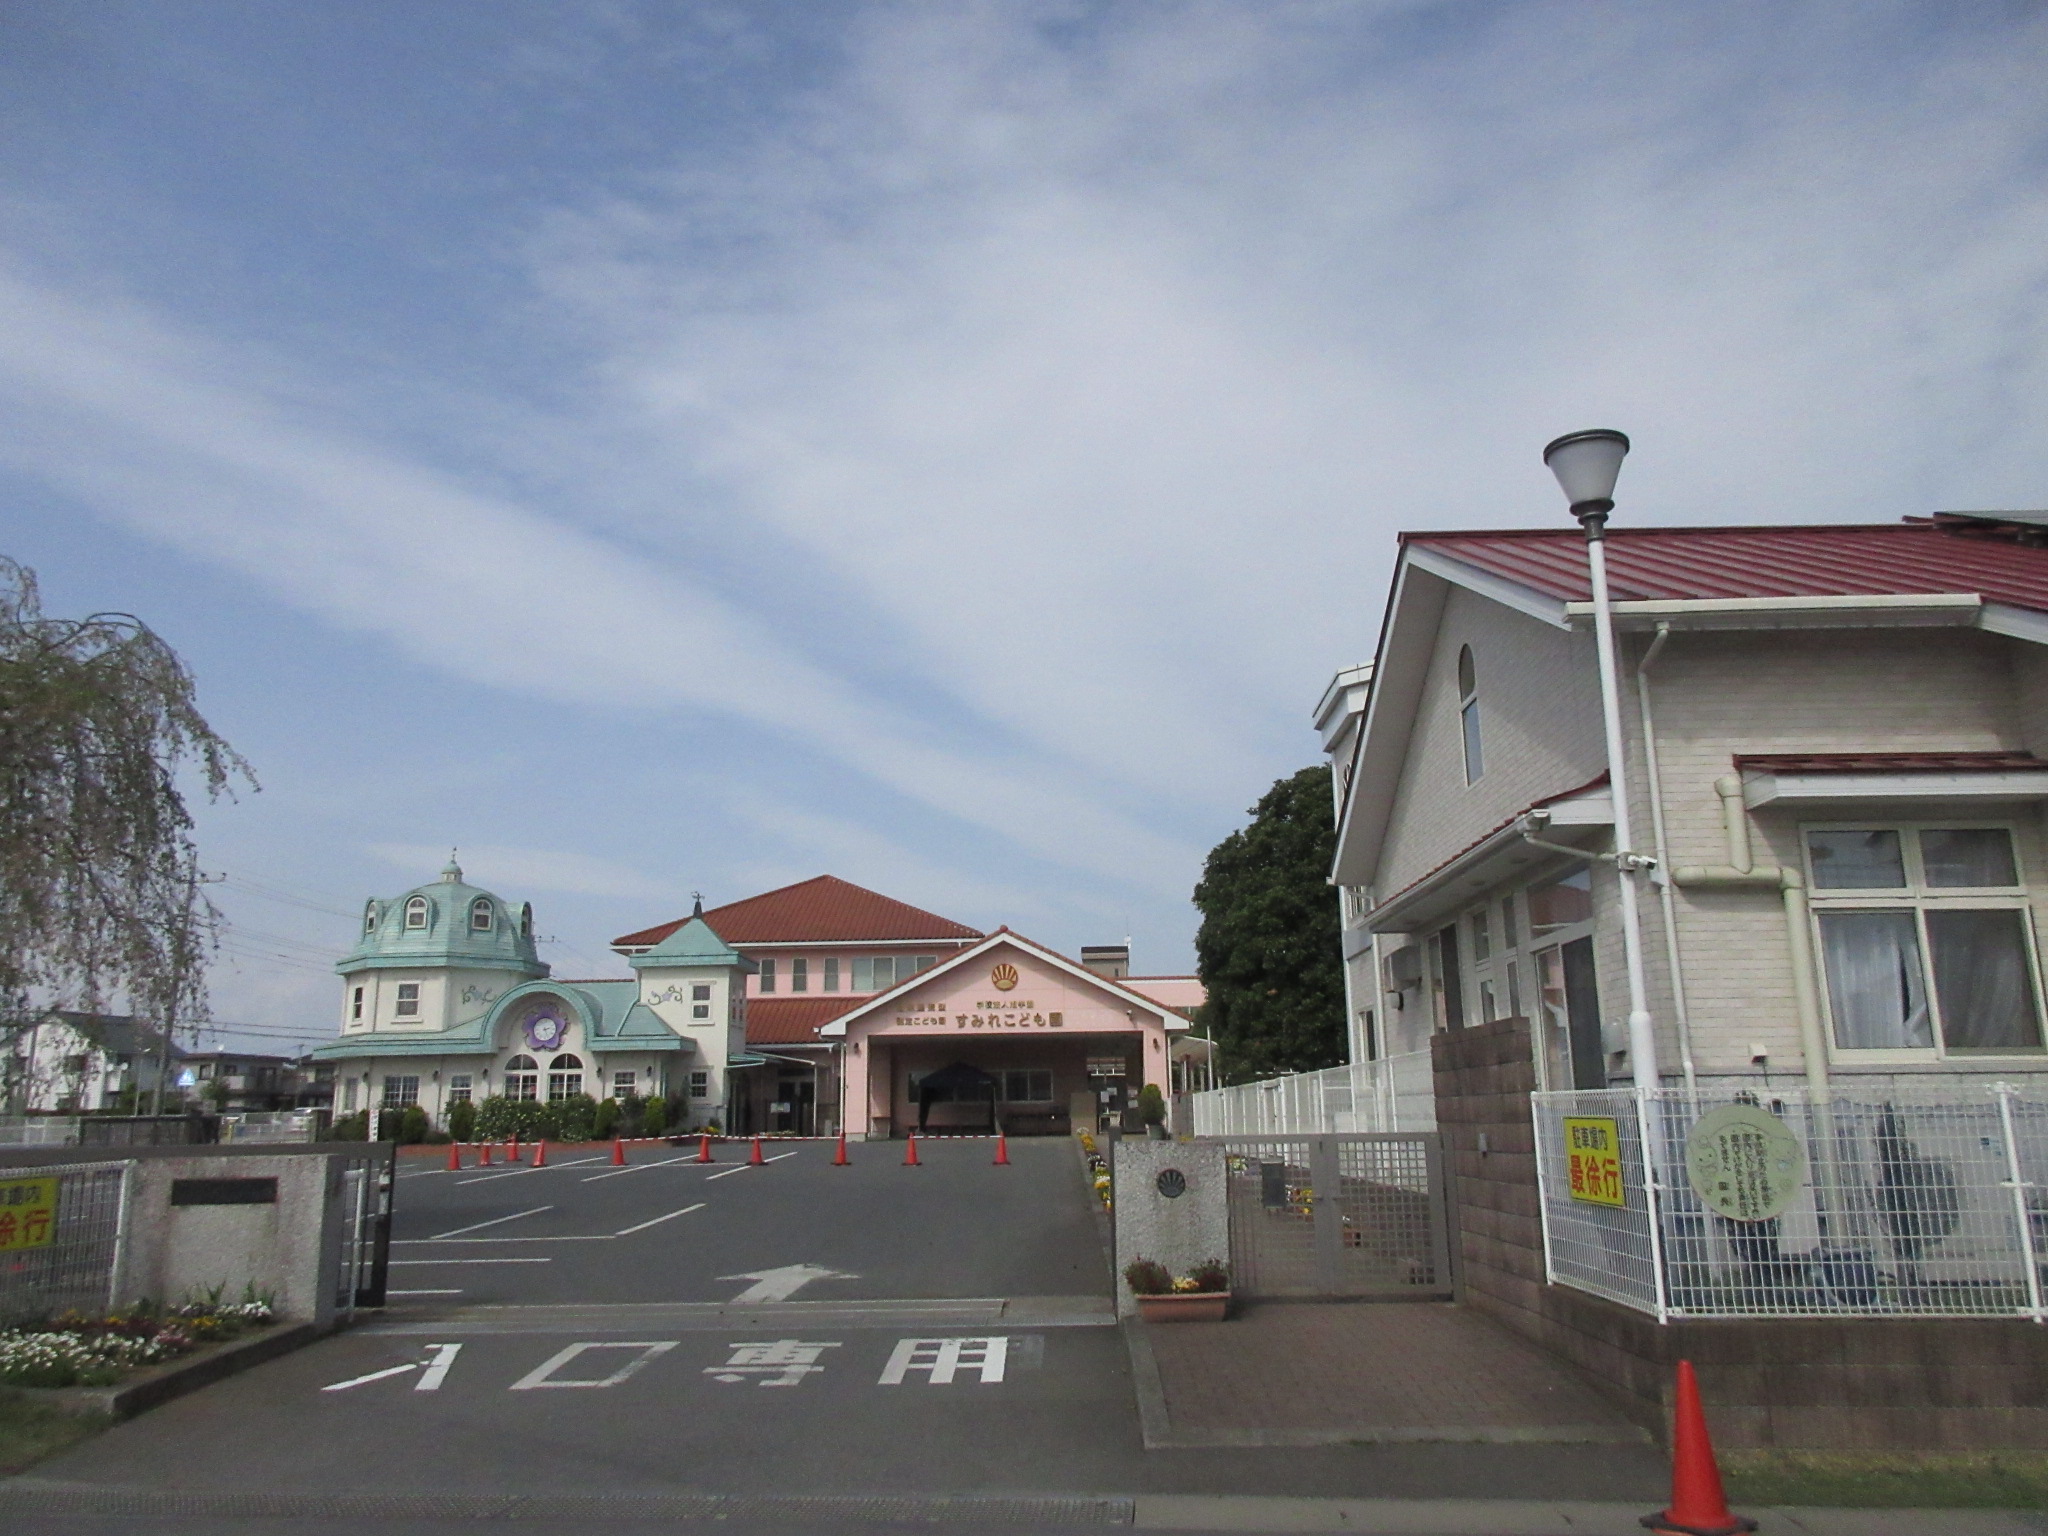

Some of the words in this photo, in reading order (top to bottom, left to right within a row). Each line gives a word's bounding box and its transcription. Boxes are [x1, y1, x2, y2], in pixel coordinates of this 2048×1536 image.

[955, 1012, 1063, 1029] すみれこども園
[1572, 1126, 1608, 1151] 駐車場内
[1570, 1154, 1618, 1198] 最徐行
[320, 1336, 1010, 1391] 入口専用
